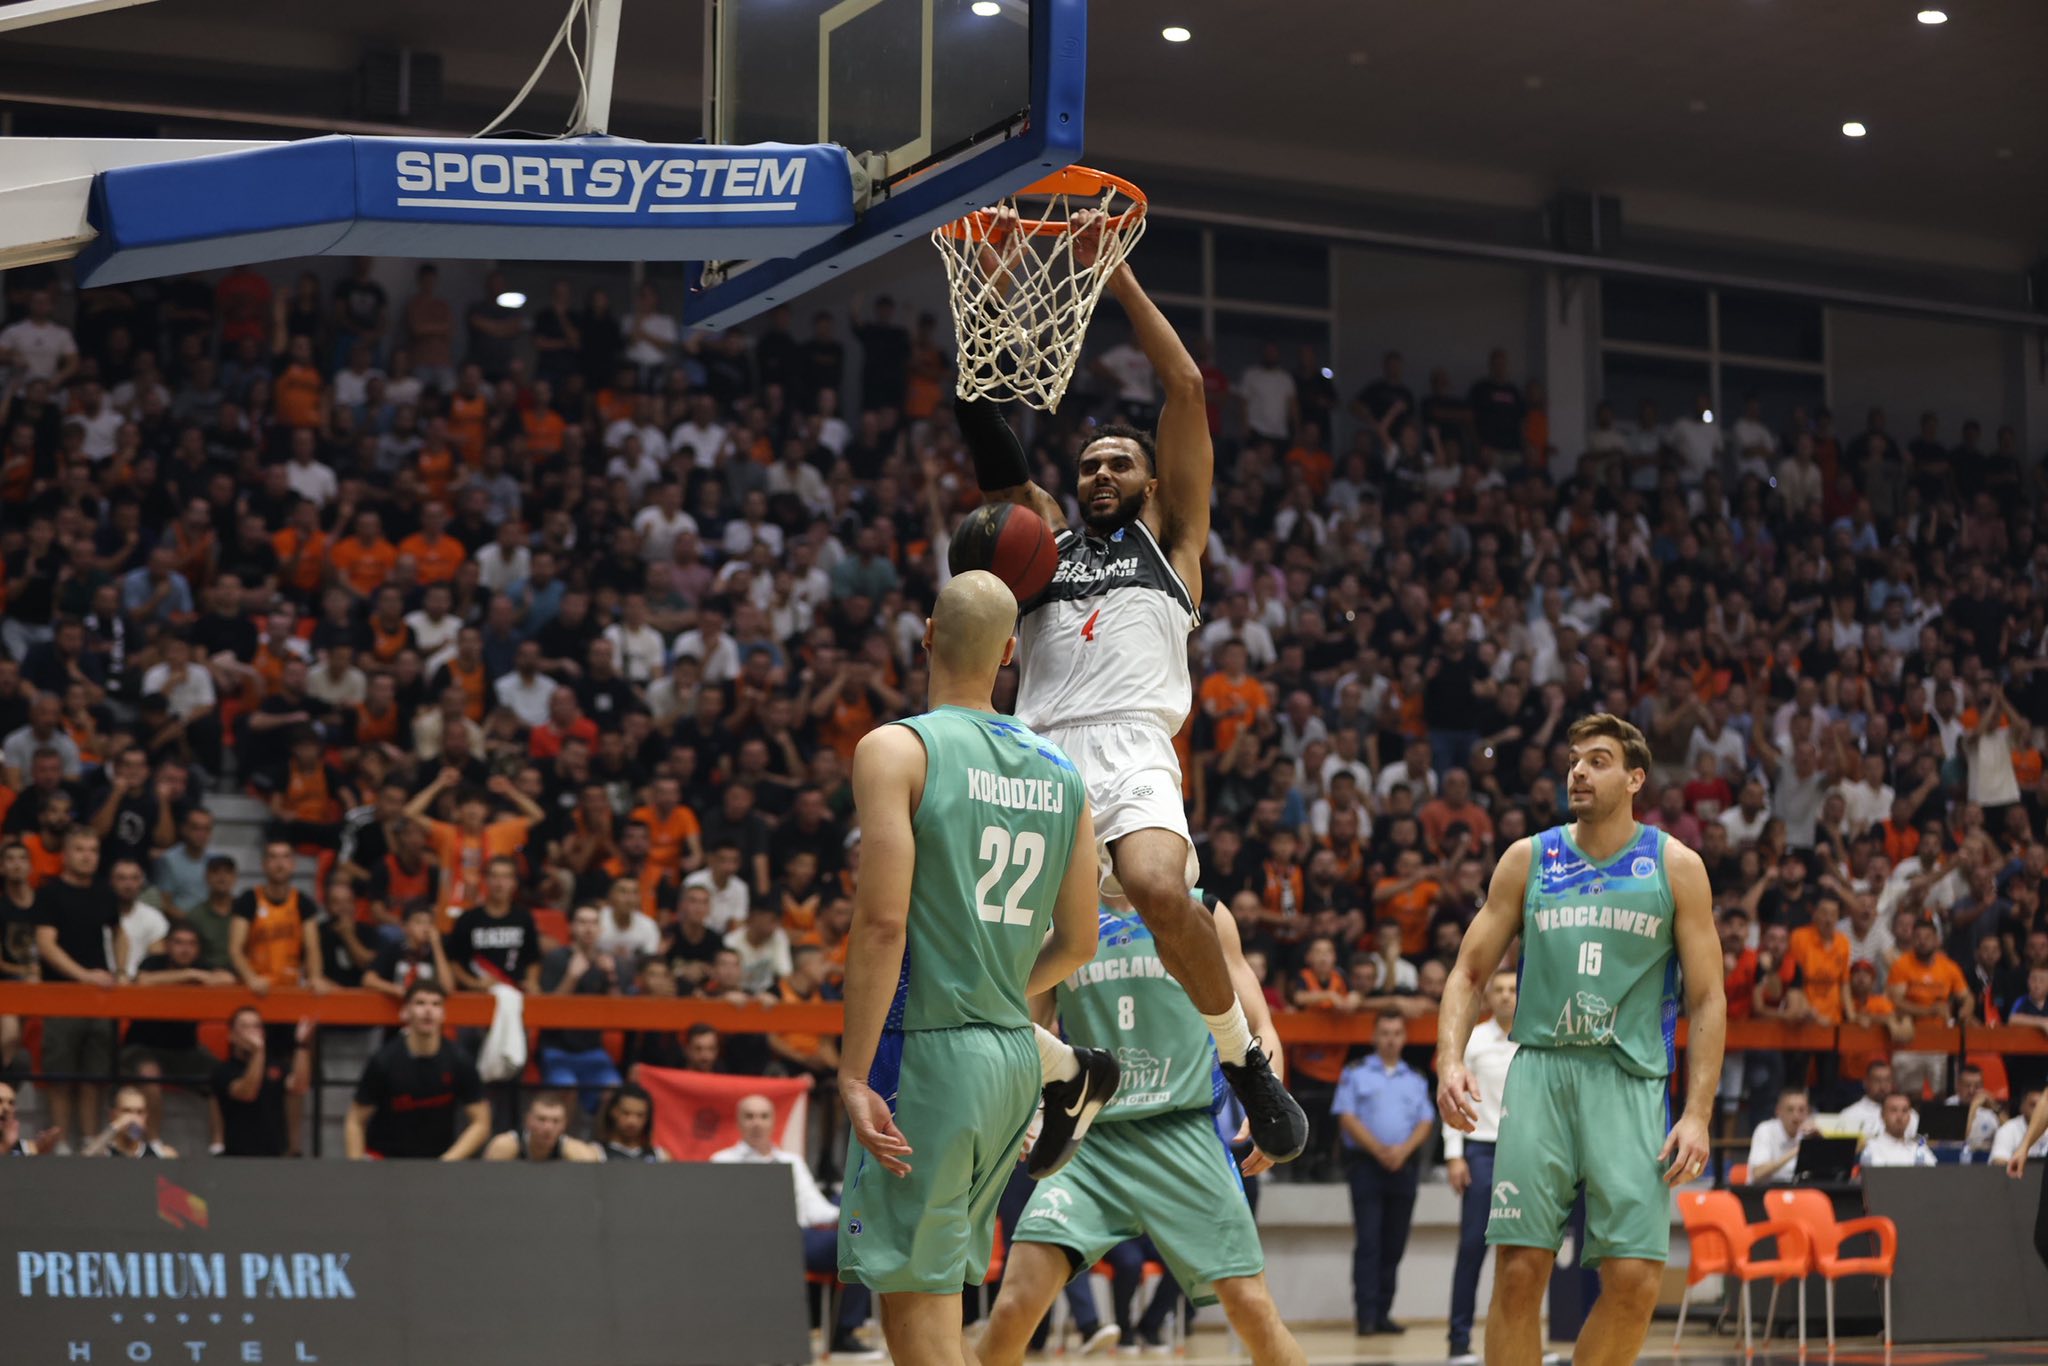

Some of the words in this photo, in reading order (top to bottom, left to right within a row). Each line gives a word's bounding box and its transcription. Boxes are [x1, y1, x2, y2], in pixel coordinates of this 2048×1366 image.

[967, 768, 1064, 814] KOŁODZIEJ
[975, 825, 1046, 927] 22
[1534, 905, 1663, 939] WŁOCŁAWEK
[1577, 941, 1603, 977] 15
[1117, 995, 1135, 1031] 8
[1118, 1056, 1172, 1091] nwil
[1490, 1207, 1521, 1219] RLEN
[17, 1250, 228, 1299] PREMIUM
[240, 1252, 356, 1300] PARK
